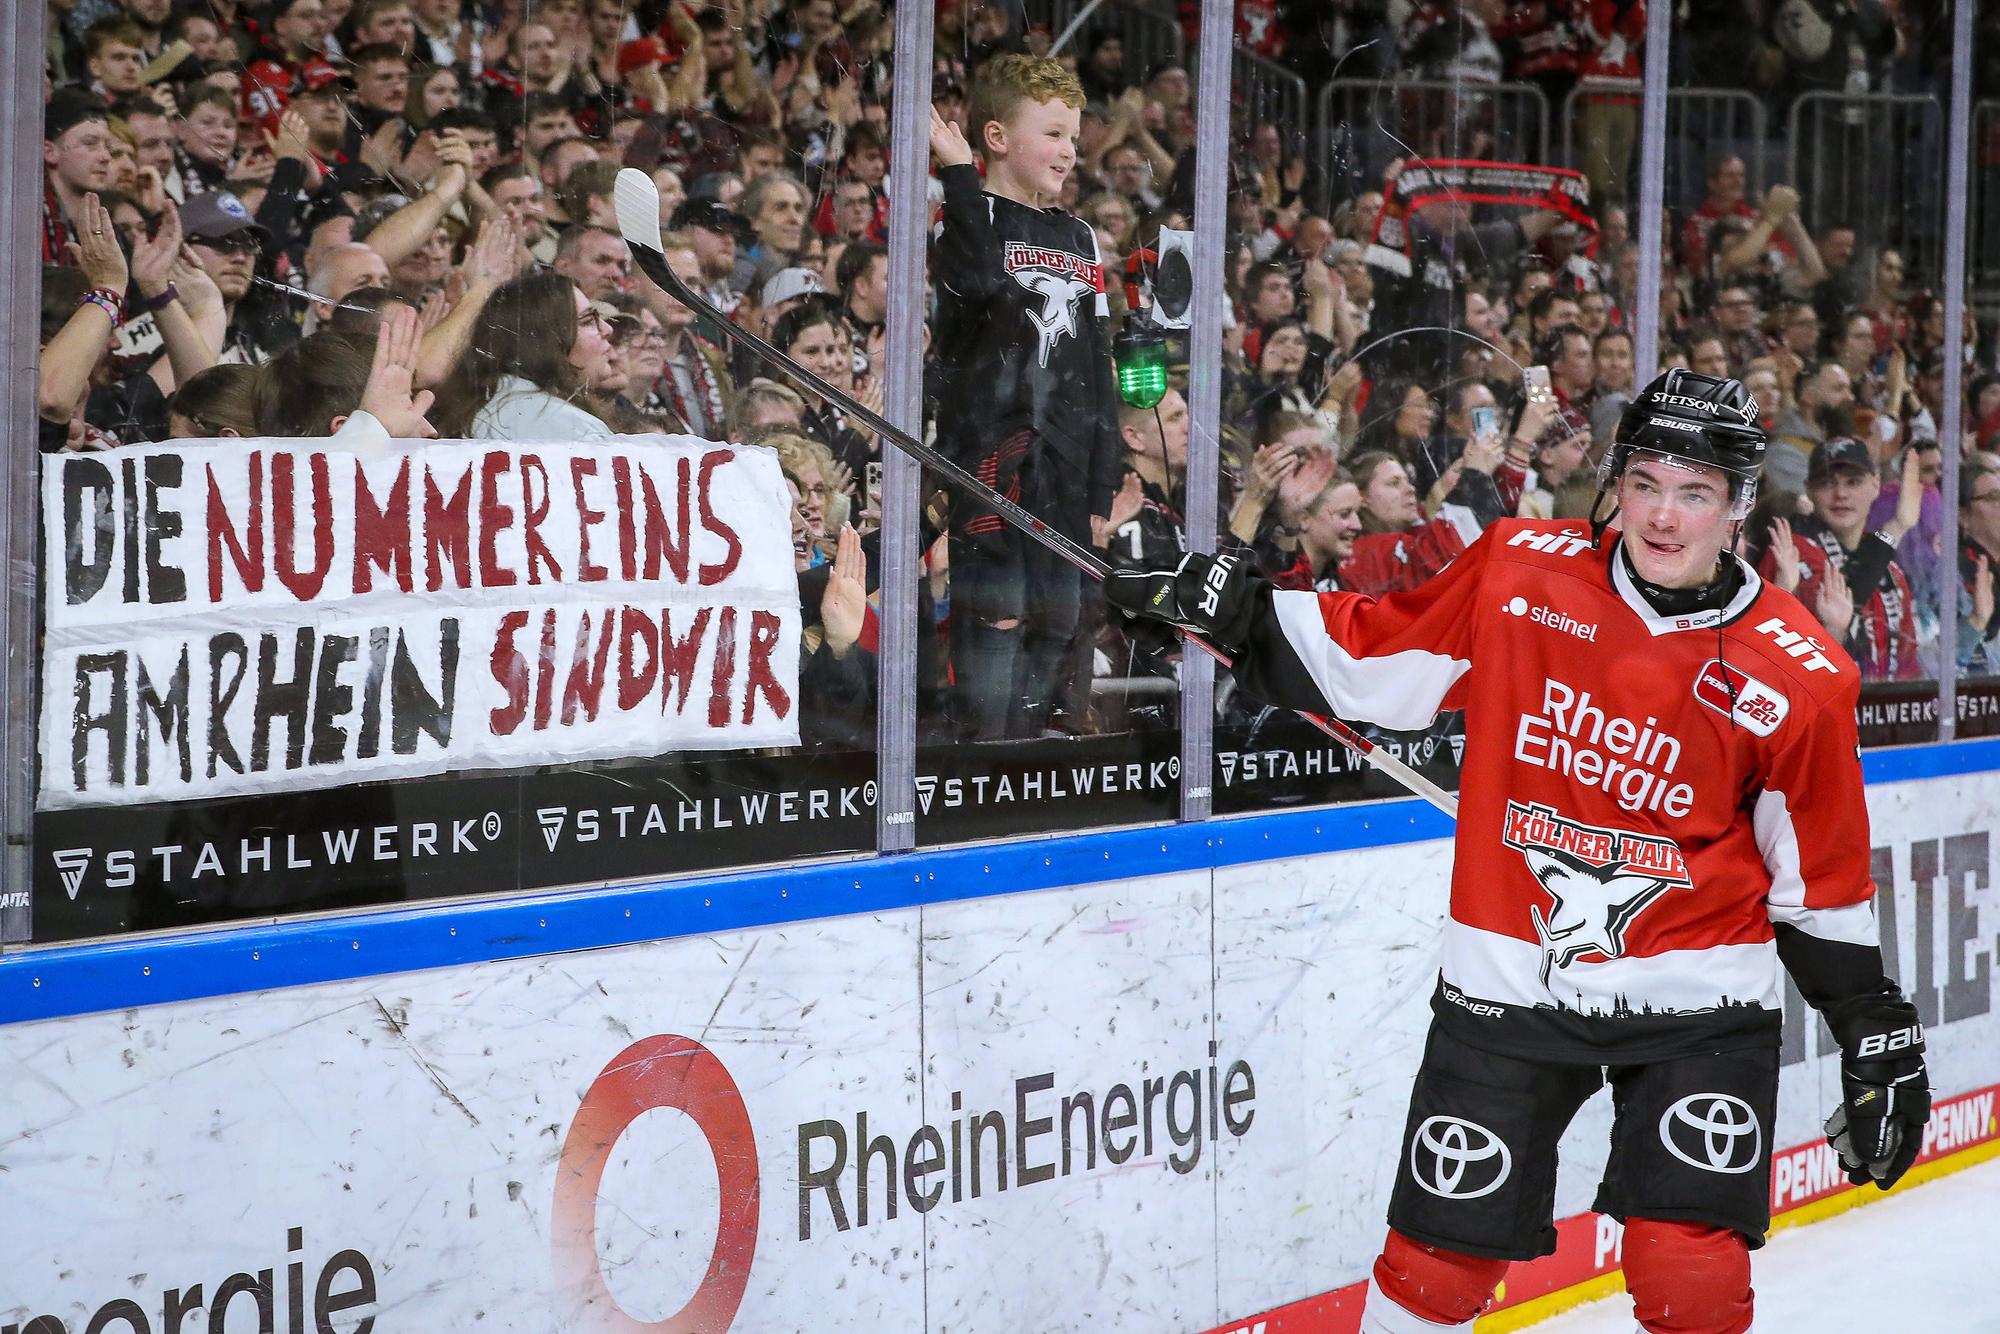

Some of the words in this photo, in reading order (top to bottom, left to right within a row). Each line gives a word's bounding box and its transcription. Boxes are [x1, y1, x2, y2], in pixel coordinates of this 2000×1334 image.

[1651, 392, 1719, 416] STETSON
[64, 453, 187, 605] DIE
[206, 450, 562, 602] NUMMER
[570, 449, 743, 586] EINS
[1506, 528, 1597, 557] HIT
[1529, 604, 1599, 643] steinel
[1754, 618, 1840, 674] HIT
[1542, 677, 1681, 775] Rhein
[1750, 693, 1777, 712] 30
[1514, 713, 1694, 818] Energie
[1508, 809, 1612, 861] KÖLNER
[1620, 838, 1688, 875] HAIE
[0, 891, 30, 910] AITA
[798, 1040, 1257, 1242] RheinEnergie
